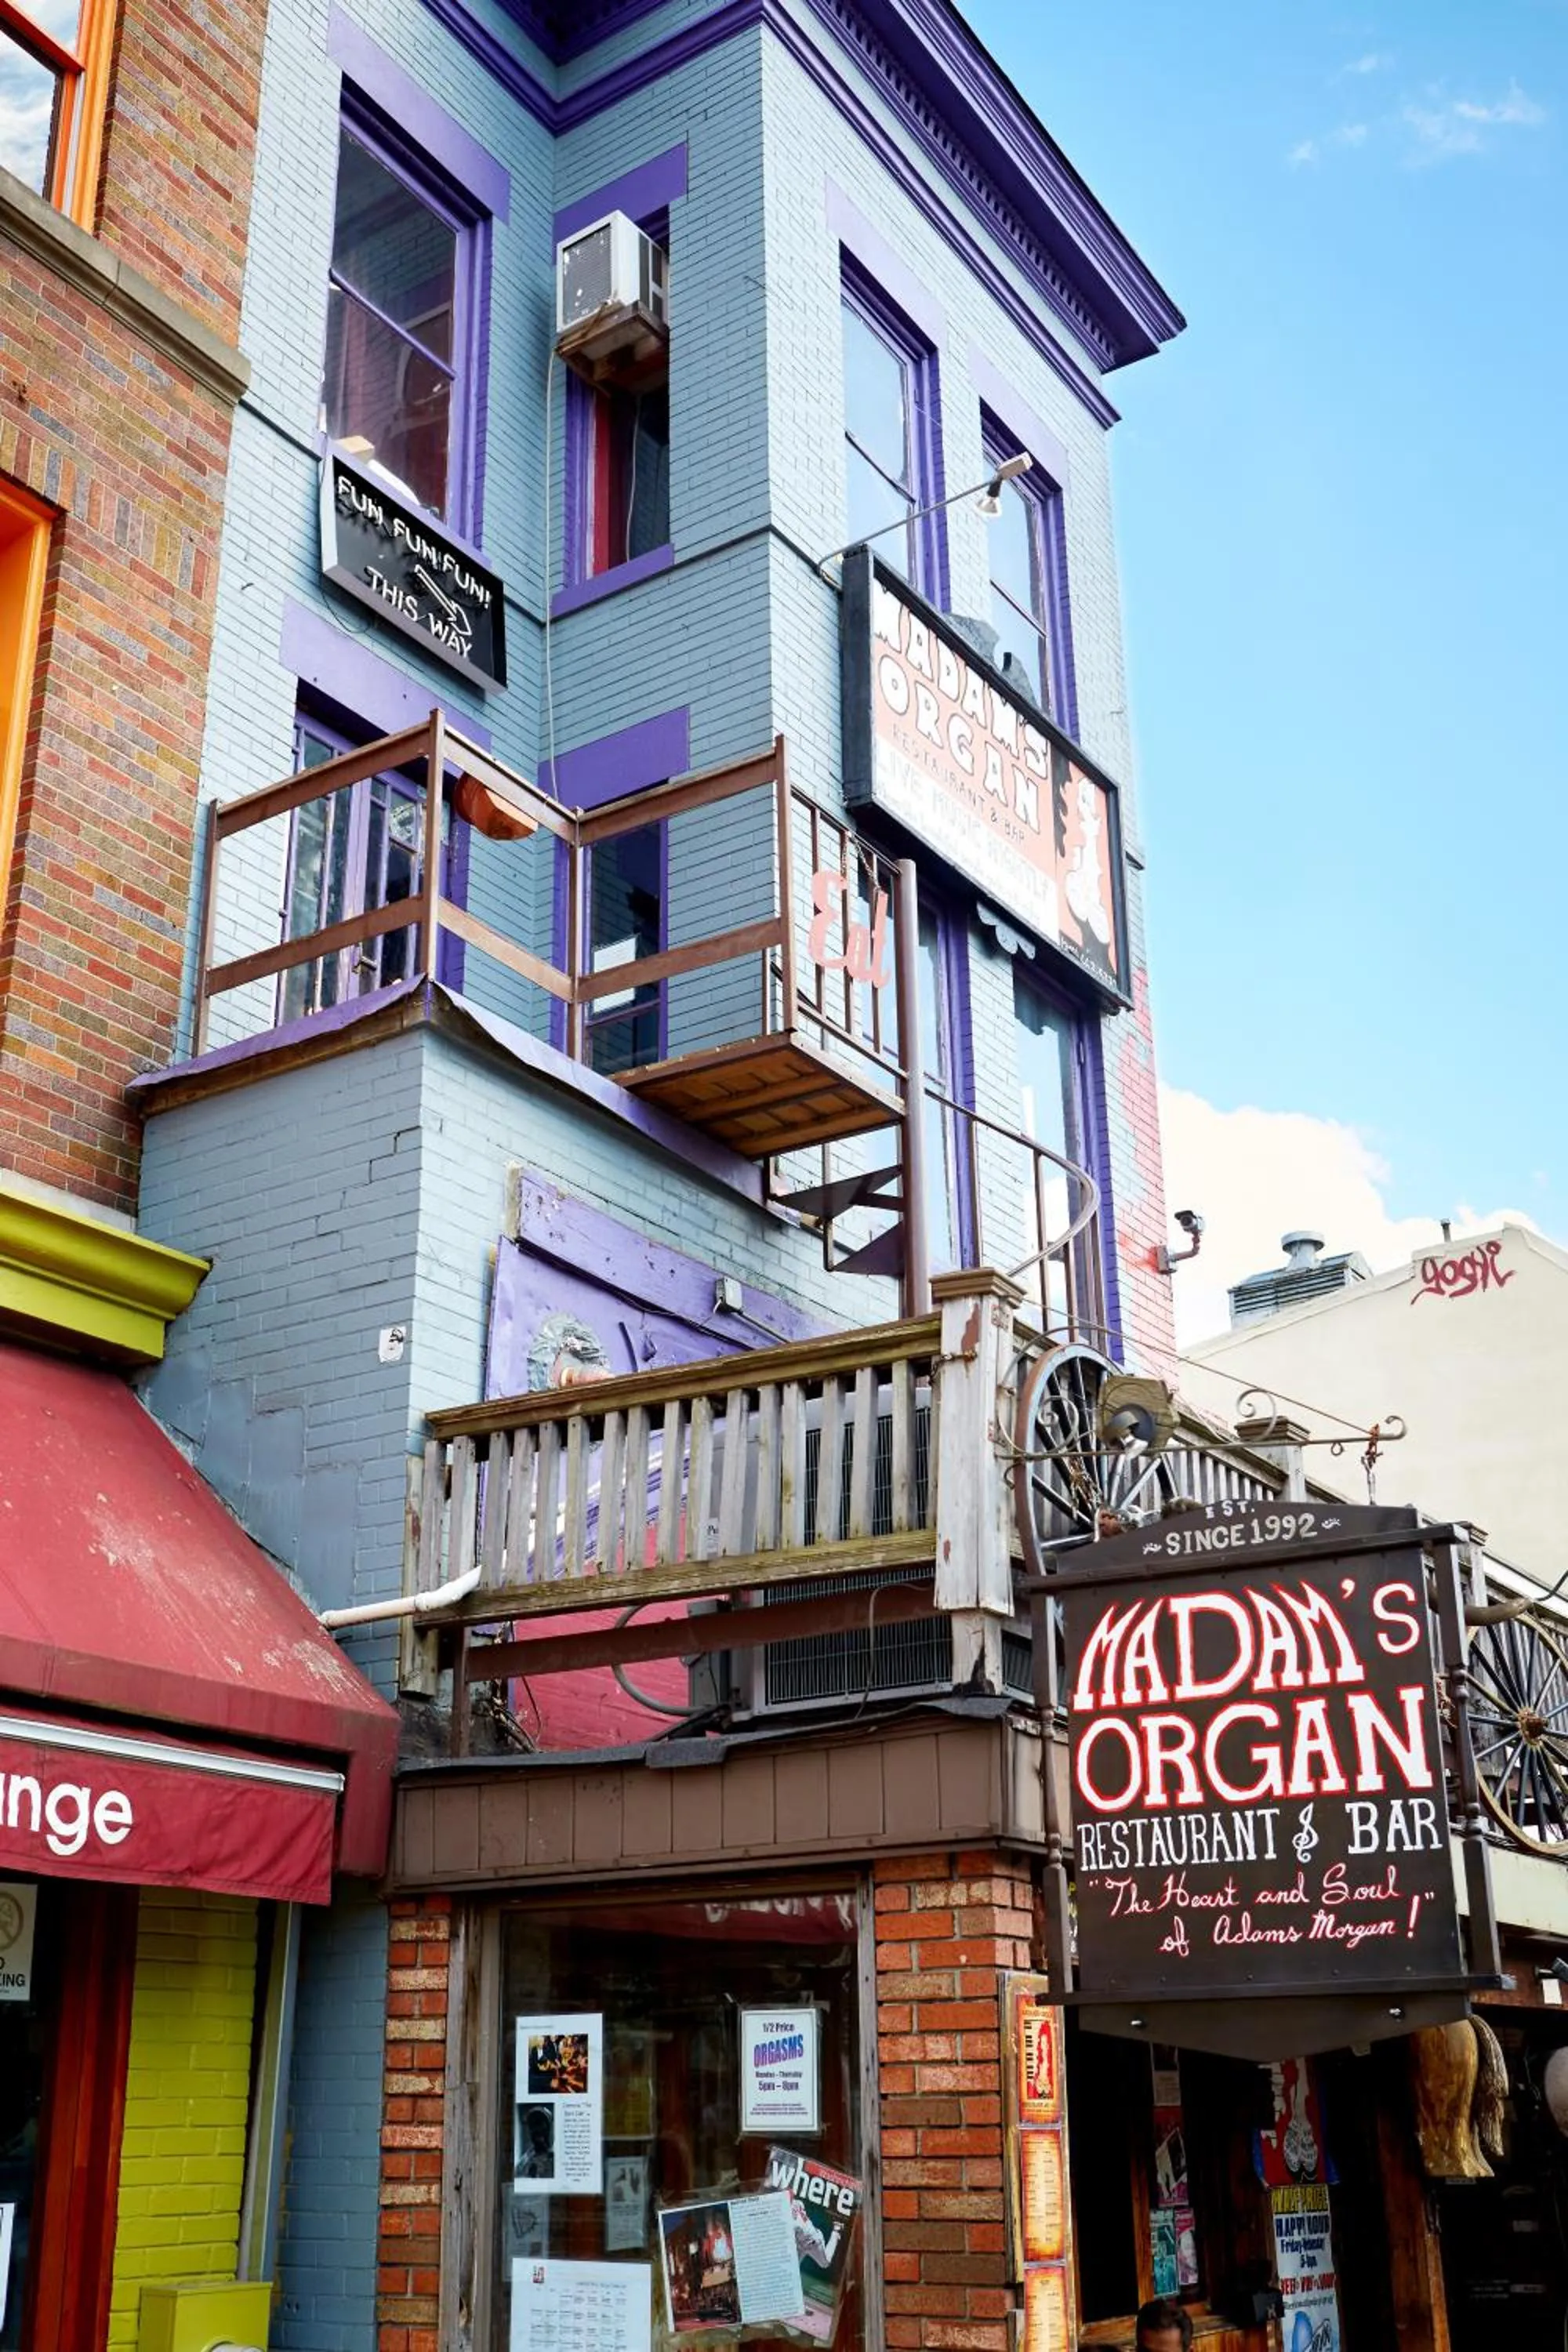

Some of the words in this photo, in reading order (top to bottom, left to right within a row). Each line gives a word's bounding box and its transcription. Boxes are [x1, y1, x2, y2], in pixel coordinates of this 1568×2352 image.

[364, 564, 419, 622] THIS
[427, 612, 473, 659] WAY
[878, 654, 1040, 836] ORGAN
[892, 723, 985, 813] RESTAURANT
[1004, 818, 1026, 846] BAR
[1166, 1524, 1247, 1555] SINCE
[1250, 1512, 1317, 1544] 1992
[1204, 1500, 1255, 1520] EST.
[1072, 1577, 1421, 1712] MADAM'S
[1076, 1685, 1434, 1813] ORGAN
[0, 1773, 133, 1857] nge
[1077, 1808, 1279, 1871] RESTAURANT
[1345, 1798, 1443, 1855] BAR
[1159, 1870, 1240, 1911] Heart
[1254, 1871, 1315, 1905] and
[1321, 1862, 1400, 1906] Soul
[1157, 1915, 1190, 1958] of
[1213, 1915, 1303, 1946] Adams
[0, 1973, 26, 1987] ING
[753, 2034, 804, 2068] ORGASMS
[775, 2022, 795, 2033] Price
[771, 2157, 854, 2217] where
